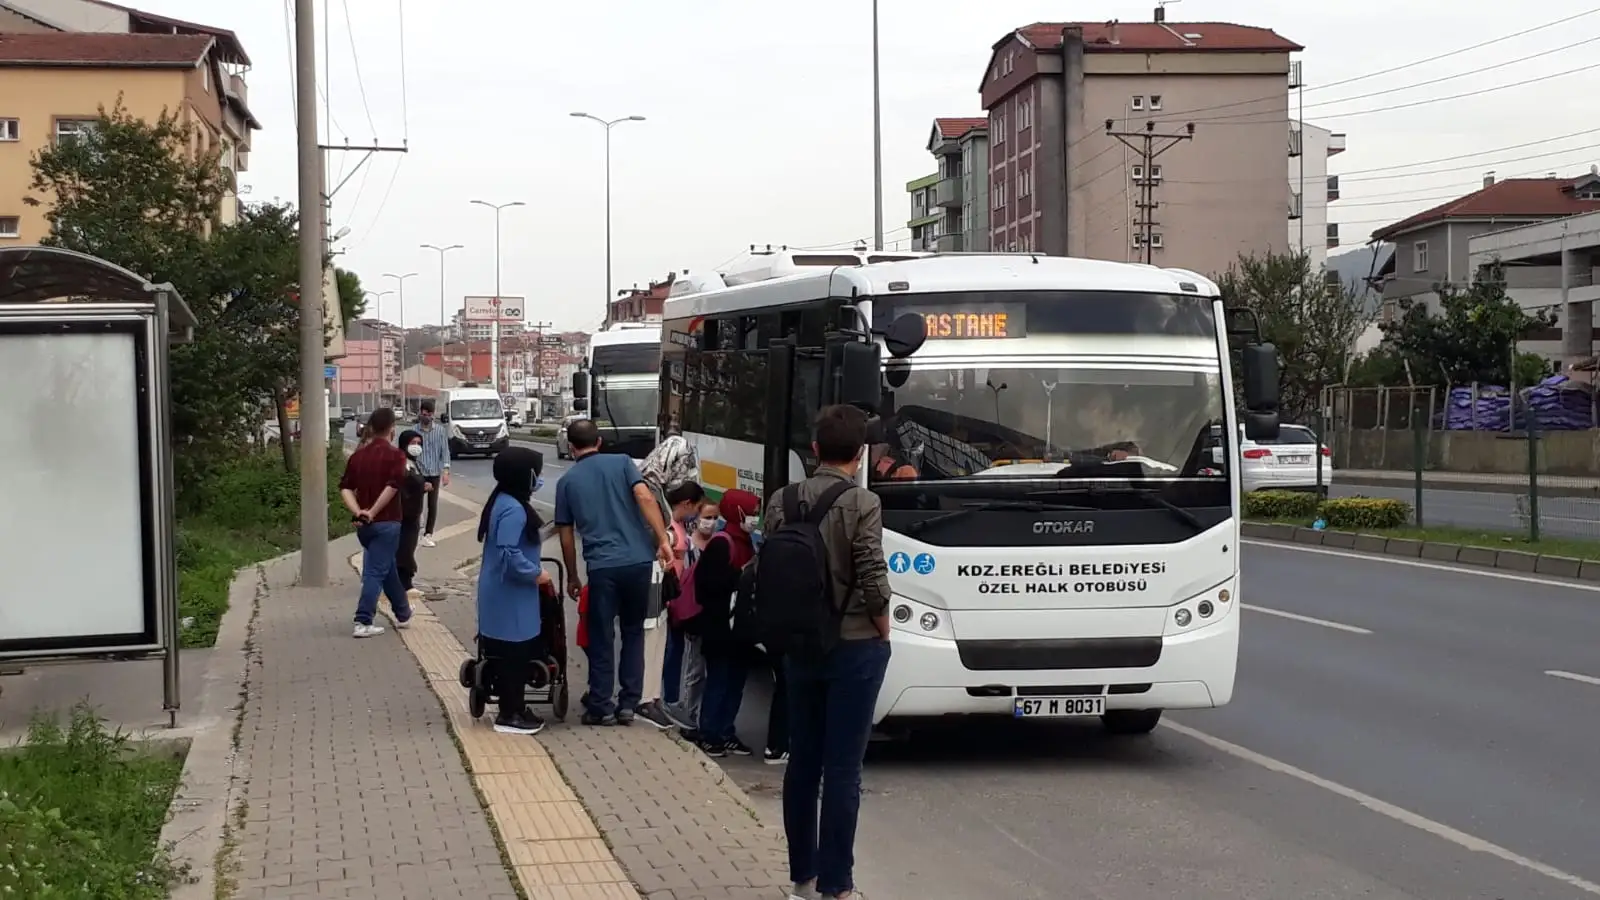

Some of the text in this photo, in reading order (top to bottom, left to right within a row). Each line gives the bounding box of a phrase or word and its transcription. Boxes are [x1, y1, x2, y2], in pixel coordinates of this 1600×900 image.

[920, 312, 1008, 337] ASTANE
[1032, 520, 1095, 534] OTOKAR
[978, 579, 1148, 594] ÖZEL HALK OTOBÜSÜ
[1023, 700, 1042, 715] 67
[1049, 699, 1058, 714] M
[1065, 699, 1102, 714] 8031
